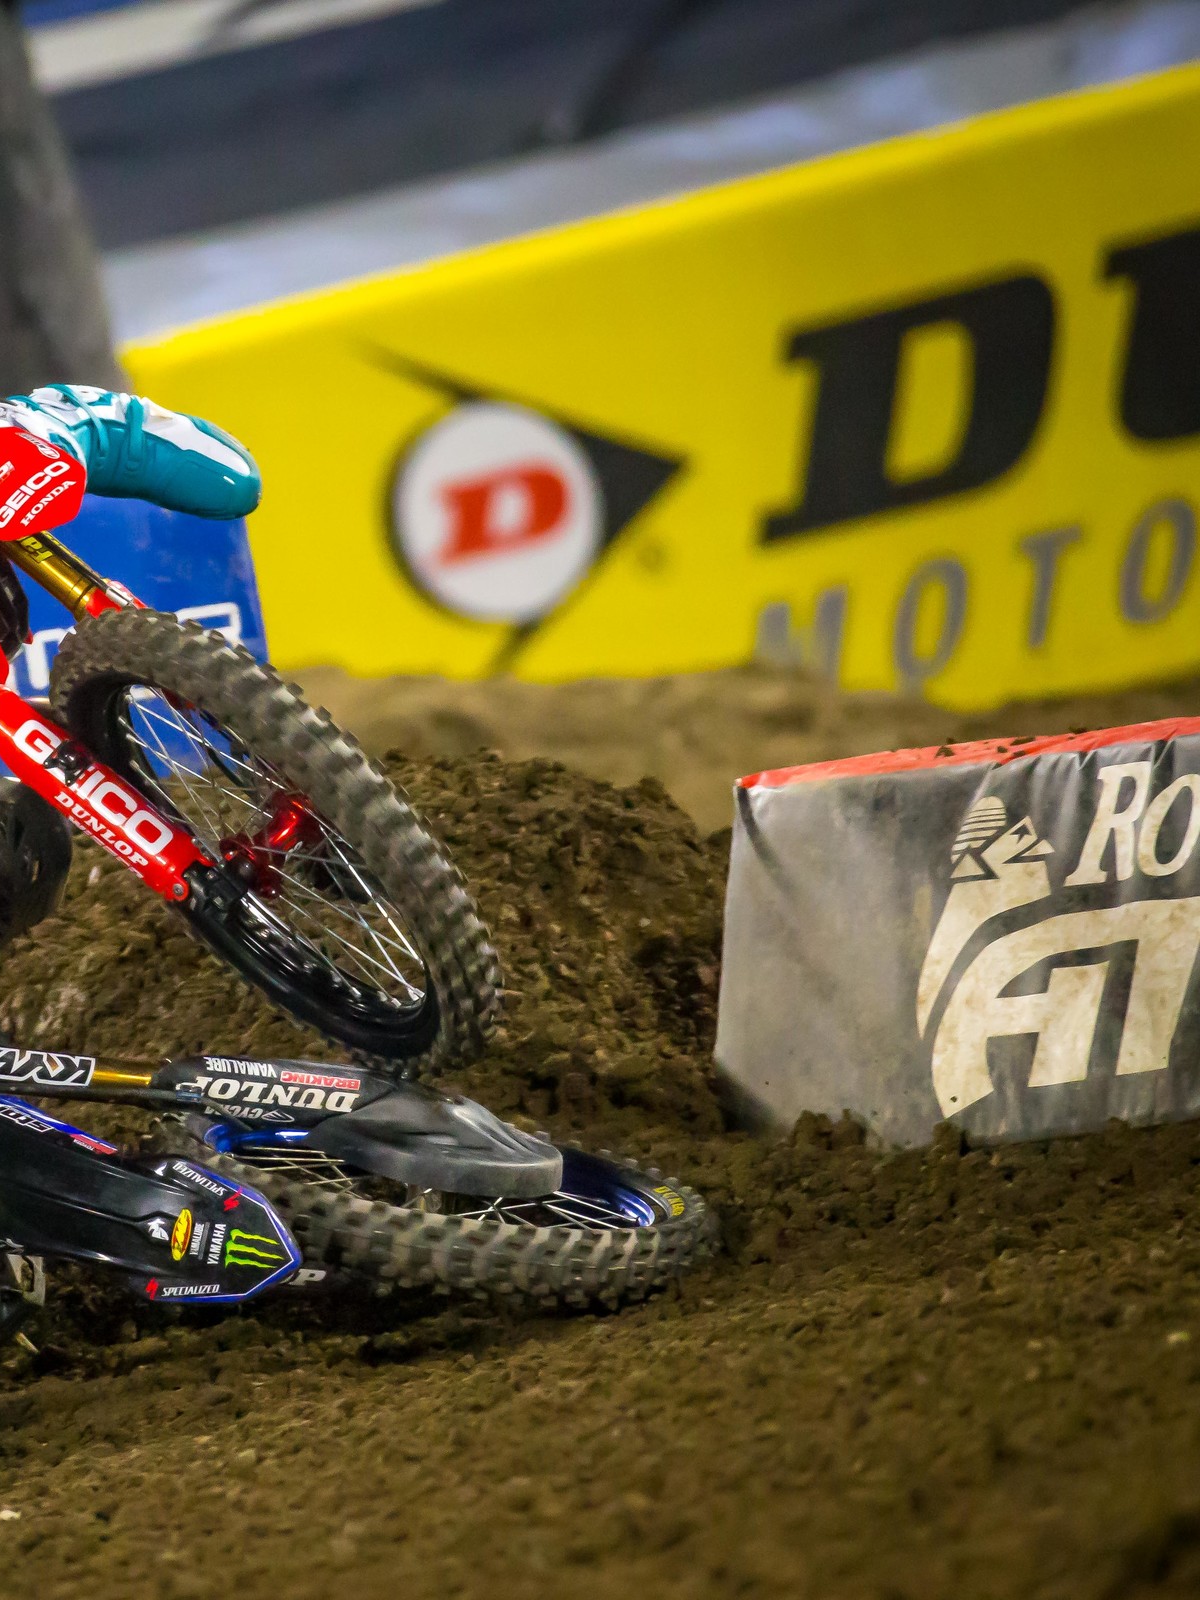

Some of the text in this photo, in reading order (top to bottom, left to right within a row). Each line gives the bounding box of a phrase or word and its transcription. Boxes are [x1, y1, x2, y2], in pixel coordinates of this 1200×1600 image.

[20, 480, 77, 527] HONDA
[438, 460, 570, 566] D
[12, 718, 174, 857] GICO
[54, 790, 150, 868] DUNLOP
[203, 1056, 277, 1079] YAMALUBE
[281, 1073, 360, 1090] BRAKING
[173, 1161, 227, 1198] SPECIALIZED
[207, 1223, 227, 1265] YAMAHA
[161, 1283, 220, 1298] SPECIALIZED
